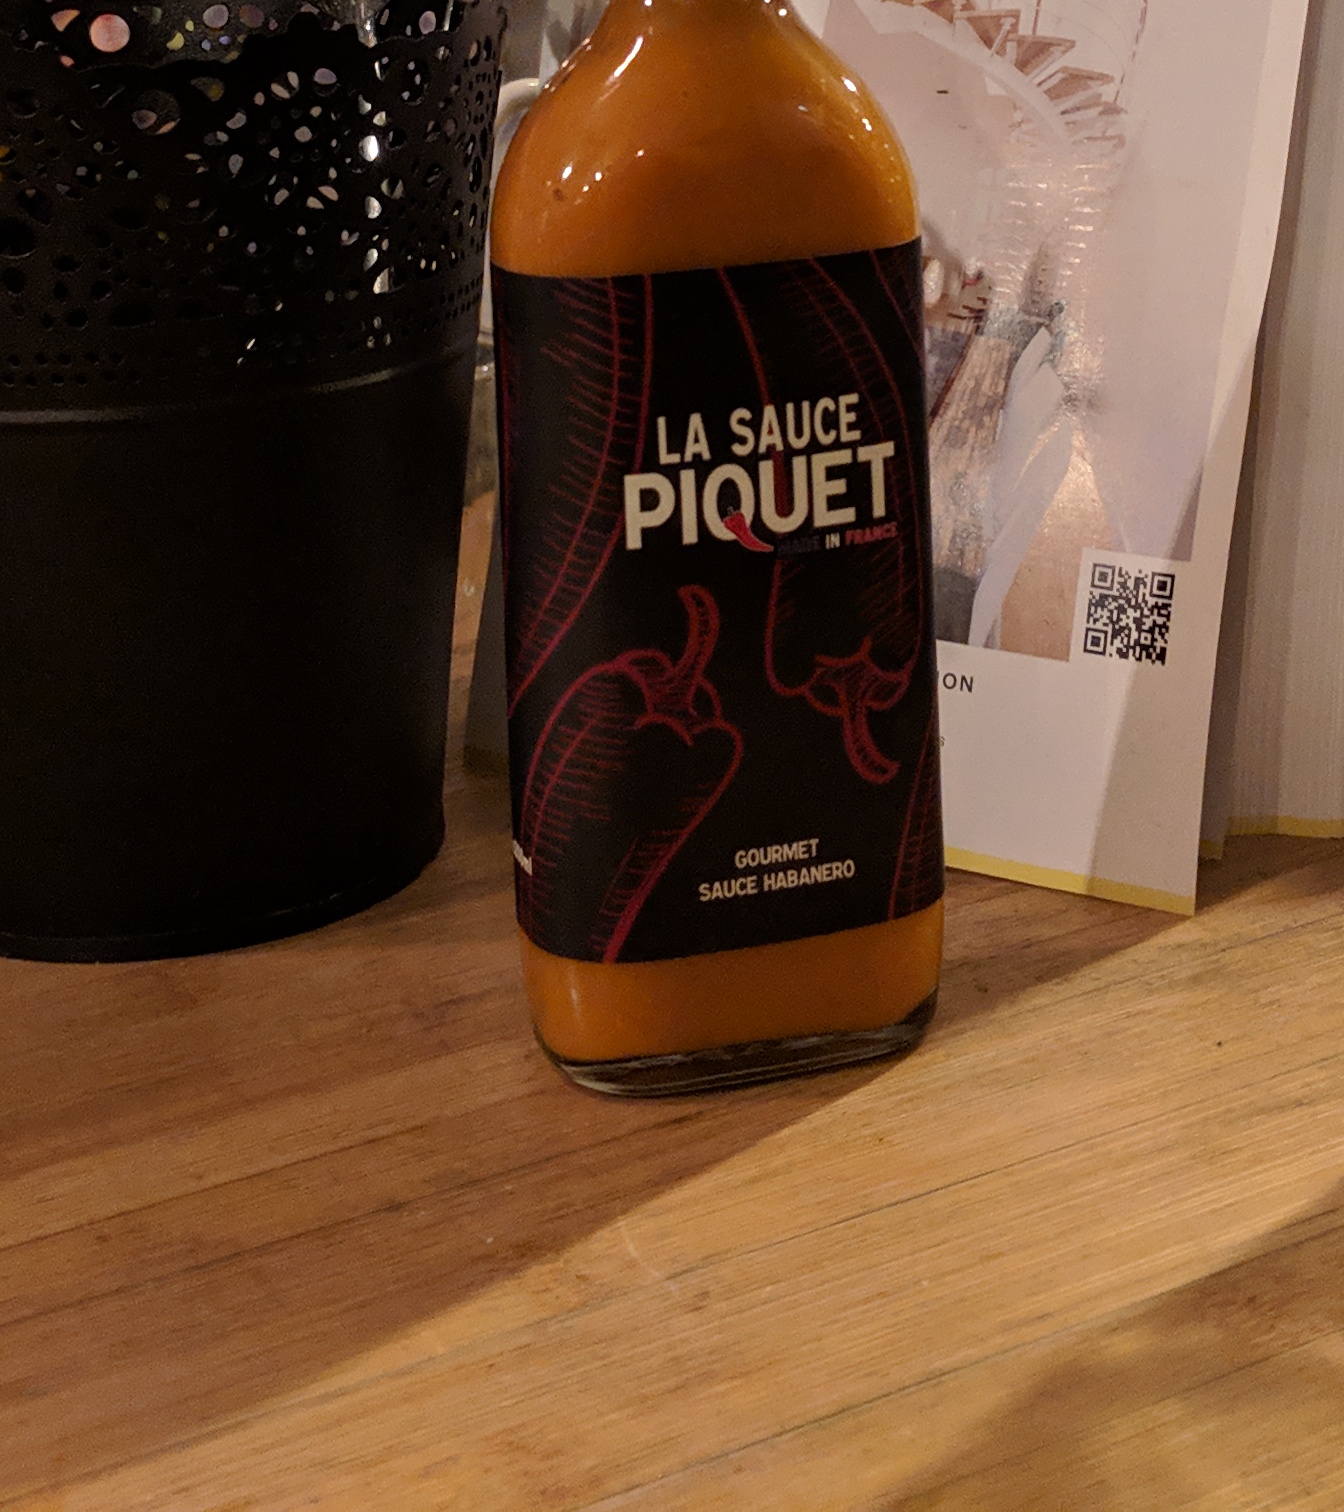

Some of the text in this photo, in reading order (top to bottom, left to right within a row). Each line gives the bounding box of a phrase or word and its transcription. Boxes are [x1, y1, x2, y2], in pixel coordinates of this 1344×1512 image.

[657, 392, 862, 465] LA SAUCE
[622, 441, 896, 551] PIQUET
[824, 532, 841, 550] IN
[845, 521, 898, 546] FRANCE
[734, 838, 819, 871] GOURMET
[698, 860, 856, 902] SAUCE HABANERO
